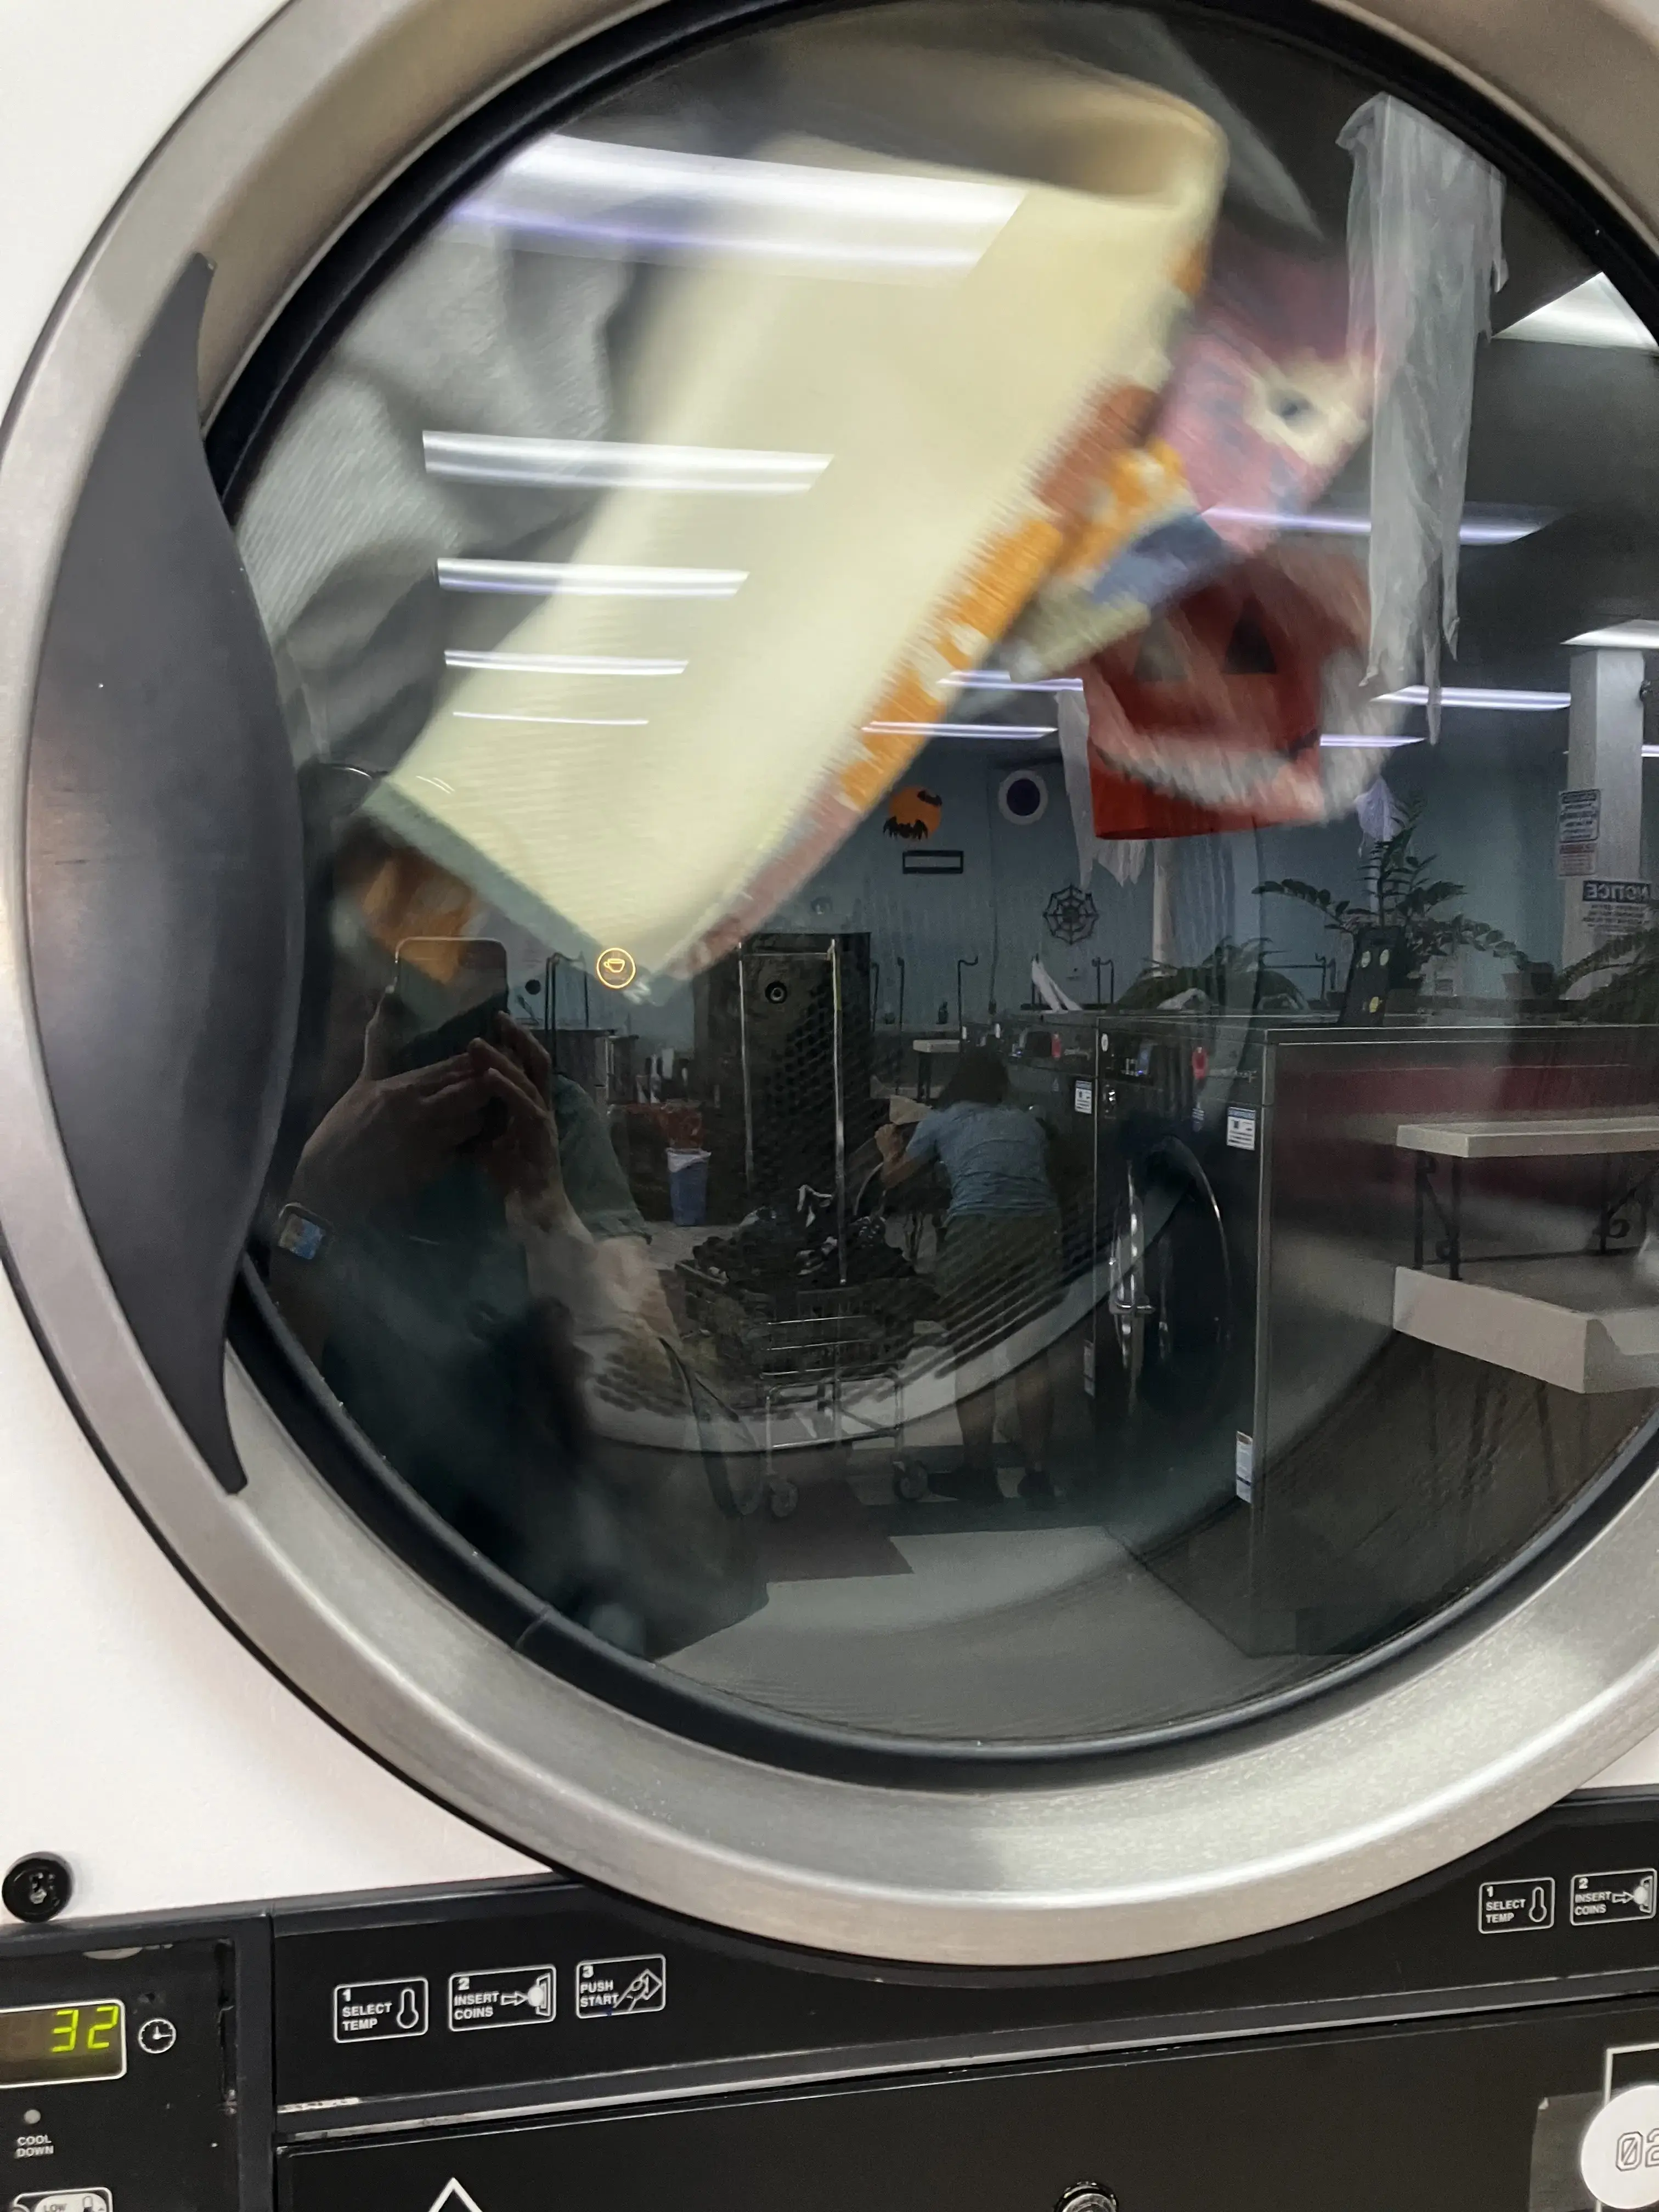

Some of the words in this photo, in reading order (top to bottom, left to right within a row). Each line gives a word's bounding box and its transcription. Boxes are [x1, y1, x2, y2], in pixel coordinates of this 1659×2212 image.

[1579, 1877, 1589, 1889] 2
[1487, 1886, 1493, 1898] 1
[1575, 1891, 1612, 1903] INSERT
[1486, 1899, 1526, 1911] SELECT
[1575, 1904, 1607, 1916] COINS
[1486, 1912, 1515, 1923] TEMP
[582, 1965, 594, 1978] 3
[458, 1977, 470, 1990] 2
[580, 1979, 614, 1994] PUSH
[342, 1988, 352, 2002] 1
[454, 1990, 500, 2006] INSERT
[580, 1992, 619, 2007] START
[342, 2002, 393, 2017] SELECT
[454, 2006, 494, 2020] COINS
[51, 2005, 119, 2052] 32
[342, 2017, 378, 2031] TEMP
[17, 2135, 52, 2146] COOL
[15, 2145, 54, 2159] DOWN
